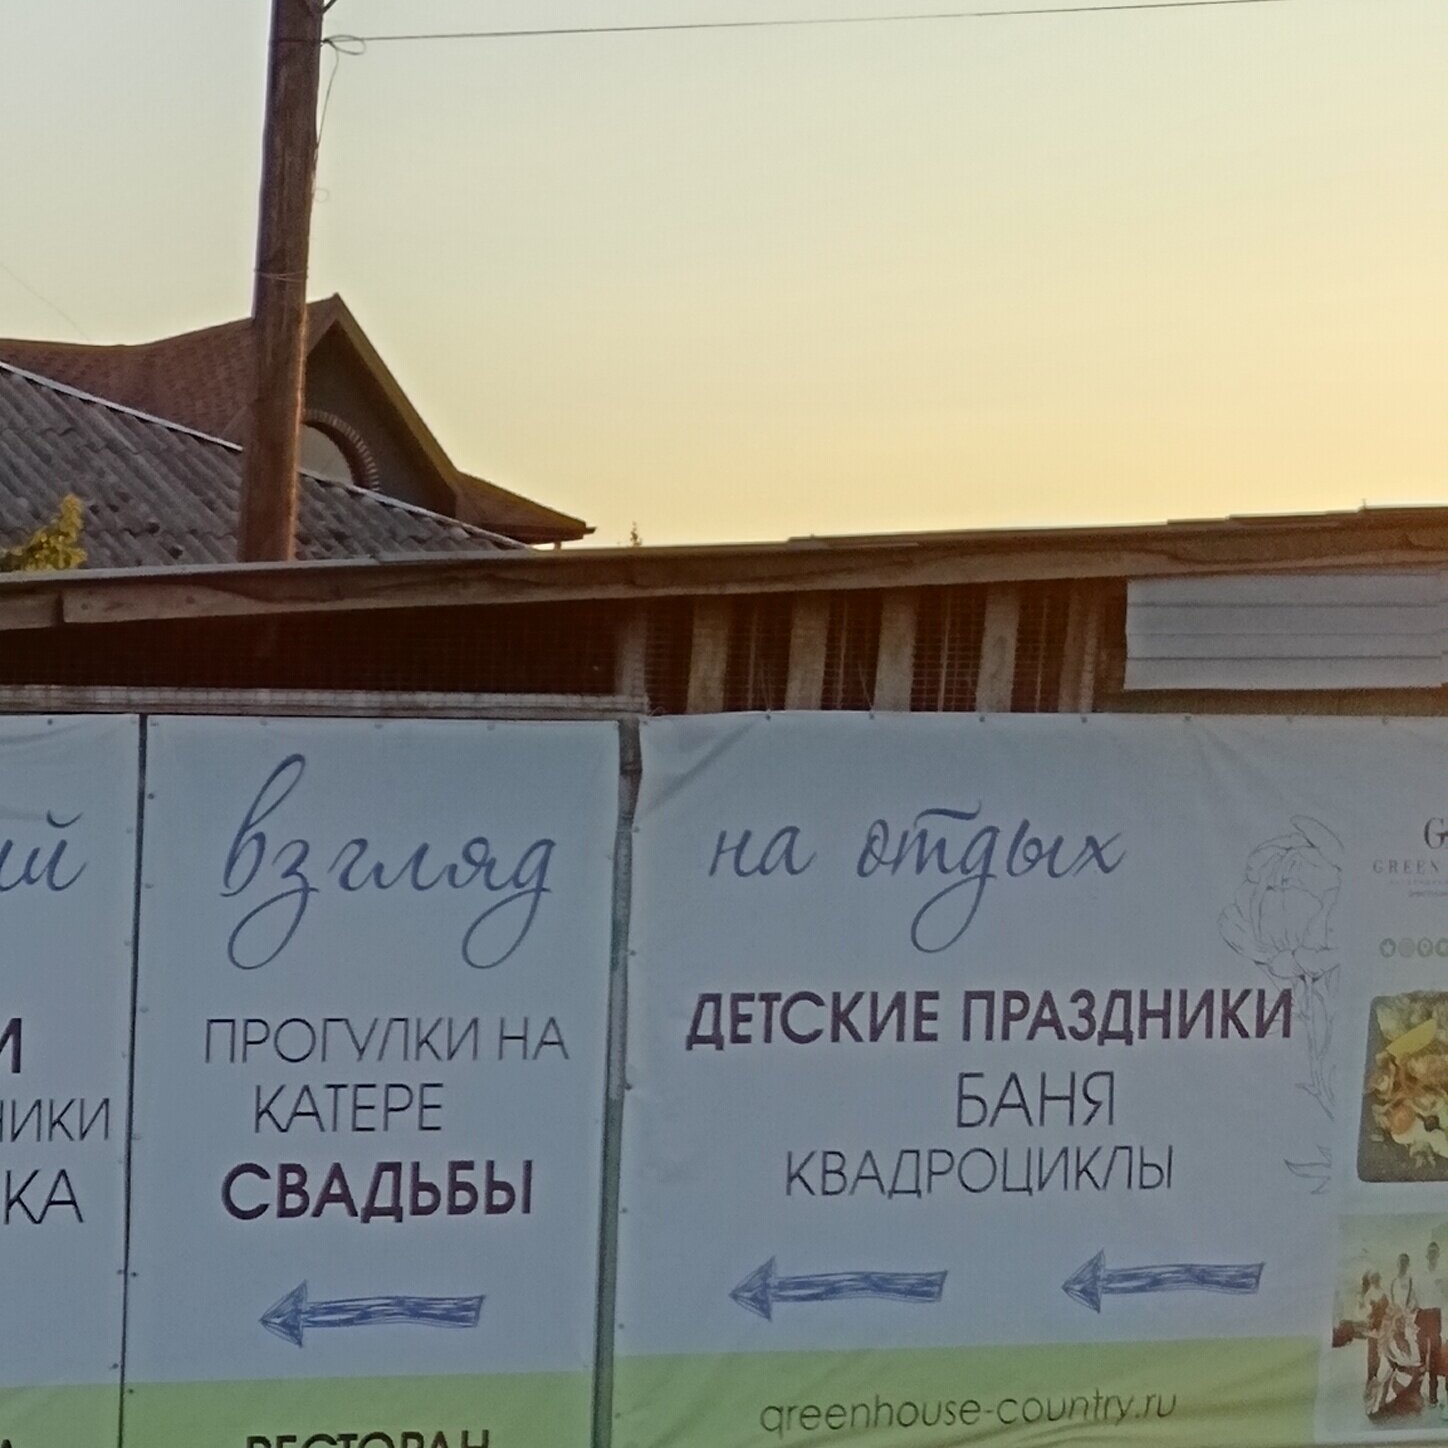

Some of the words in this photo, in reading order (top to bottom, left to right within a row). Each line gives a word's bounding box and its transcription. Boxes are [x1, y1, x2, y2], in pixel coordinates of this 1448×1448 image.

[219, 753, 562, 970] взгляд
[707, 825, 815, 879] на
[856, 799, 1126, 954] отдых
[203, 1017, 480, 1065] ПРОГУЛКИ
[497, 1015, 571, 1062] НА
[685, 988, 939, 1052] ДЕТСКИЕ
[960, 987, 1293, 1047] ПРАЗДНИКИ
[254, 1082, 445, 1134] КАТЕРЕ
[955, 1070, 1117, 1130] БАНЯ
[220, 1159, 533, 1225] СВАДЬБЫ
[785, 1144, 1174, 1201] КВАДРОЦИКЛЫ
[759, 1389, 1178, 1438] greenhouse-country.ru
